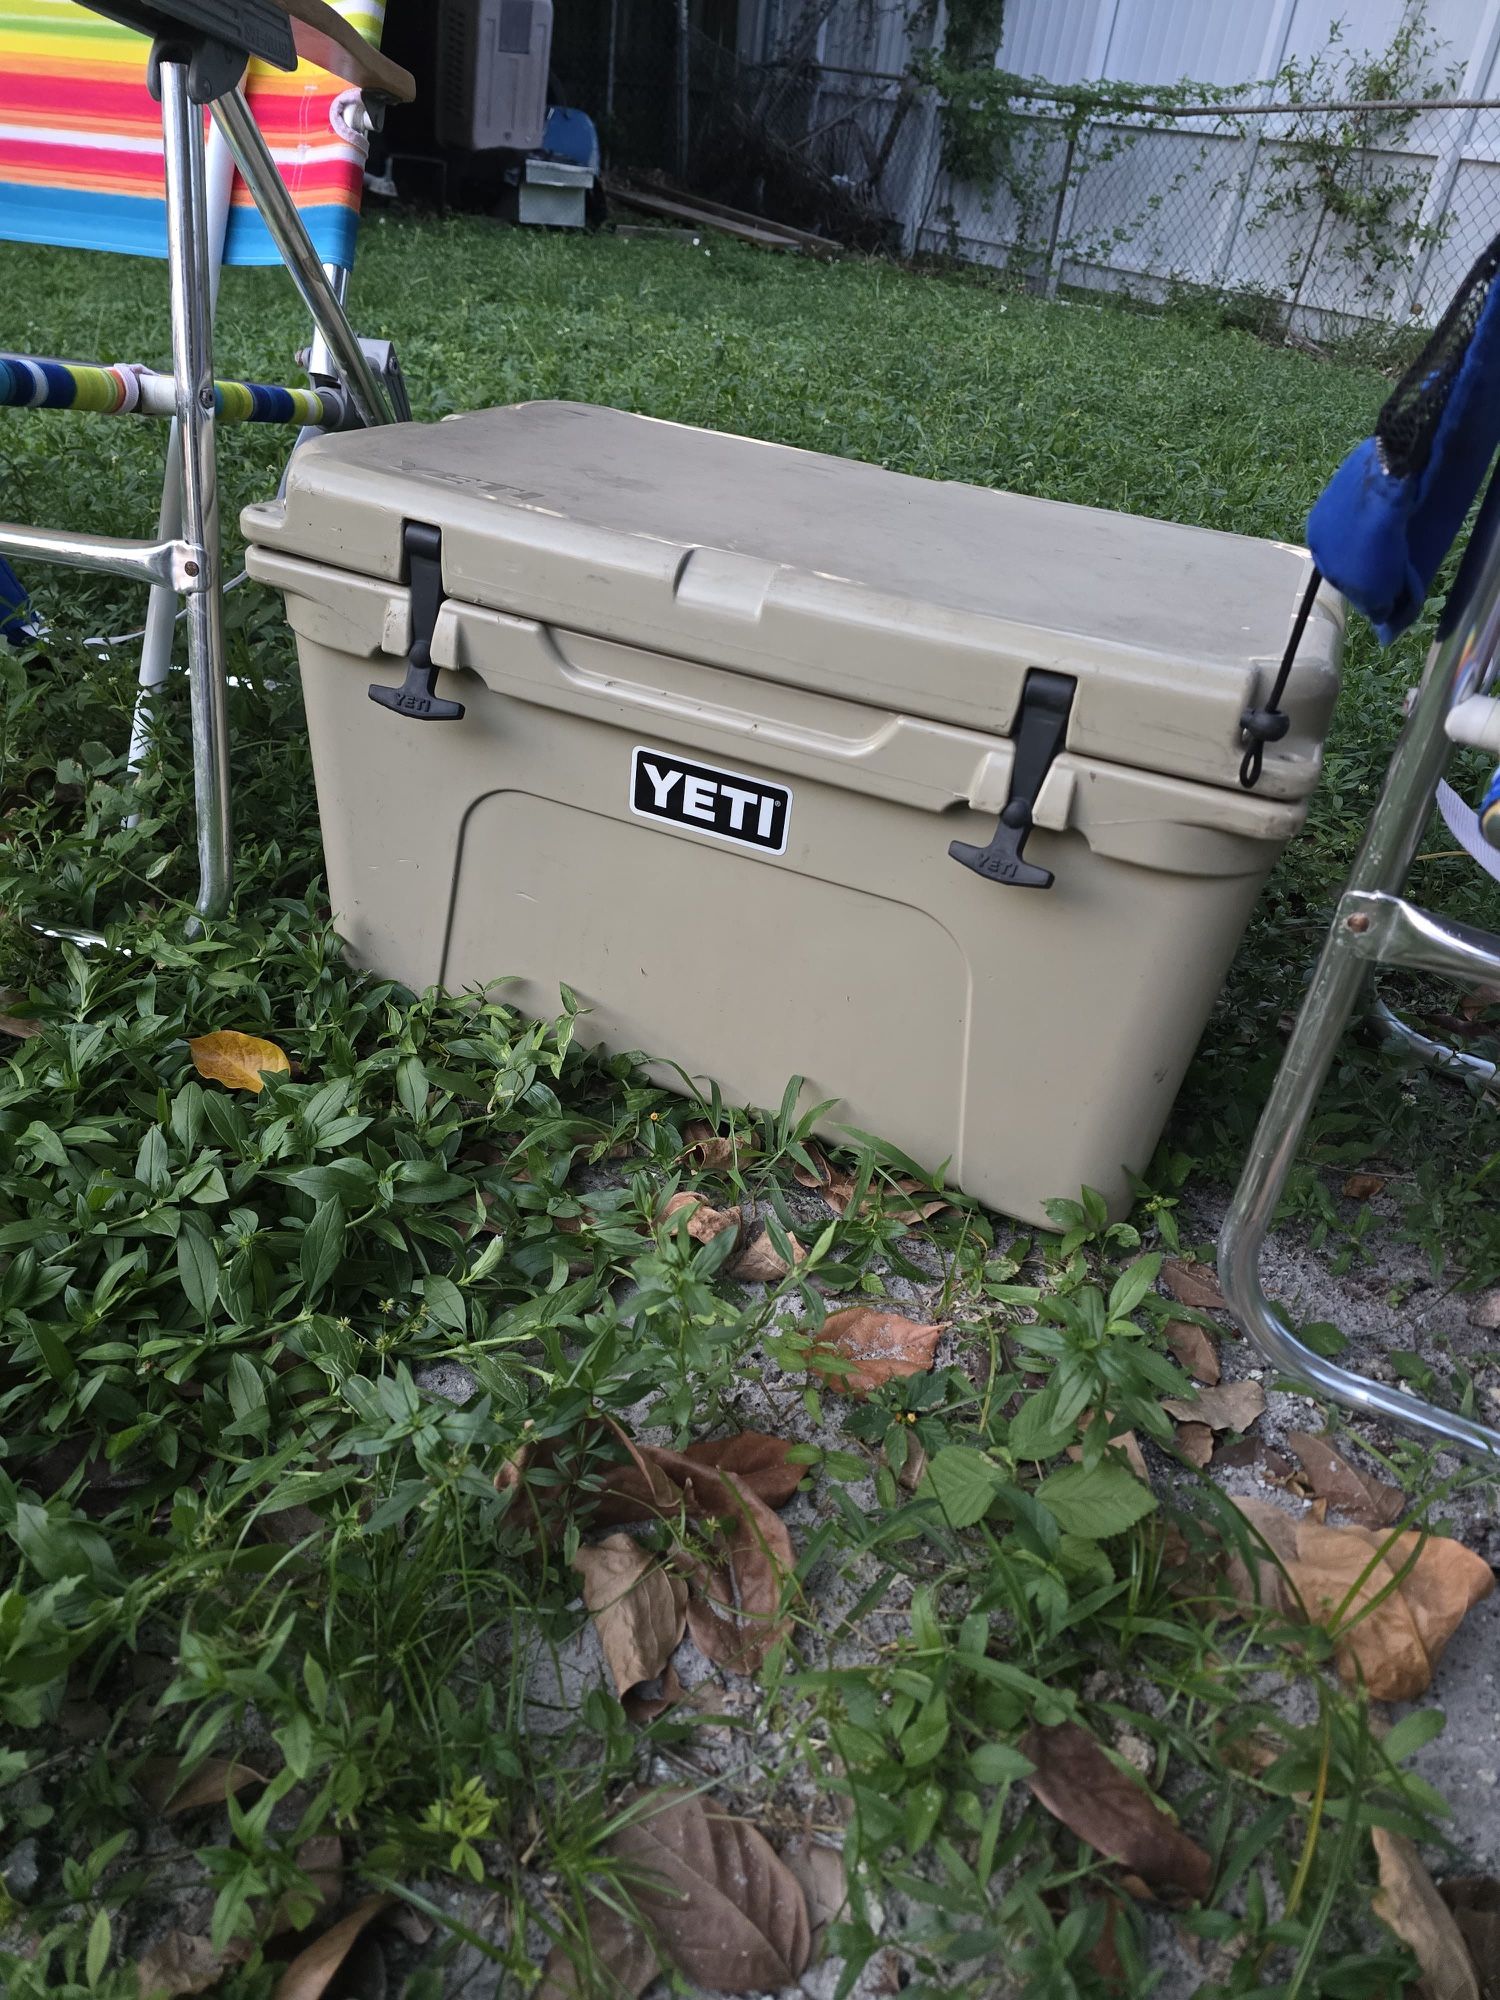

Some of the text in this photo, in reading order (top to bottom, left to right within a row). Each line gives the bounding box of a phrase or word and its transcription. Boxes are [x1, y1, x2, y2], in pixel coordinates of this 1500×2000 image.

[395, 692, 431, 712] YETI
[642, 762, 775, 839] YETI
[977, 853, 1019, 878] YETI
